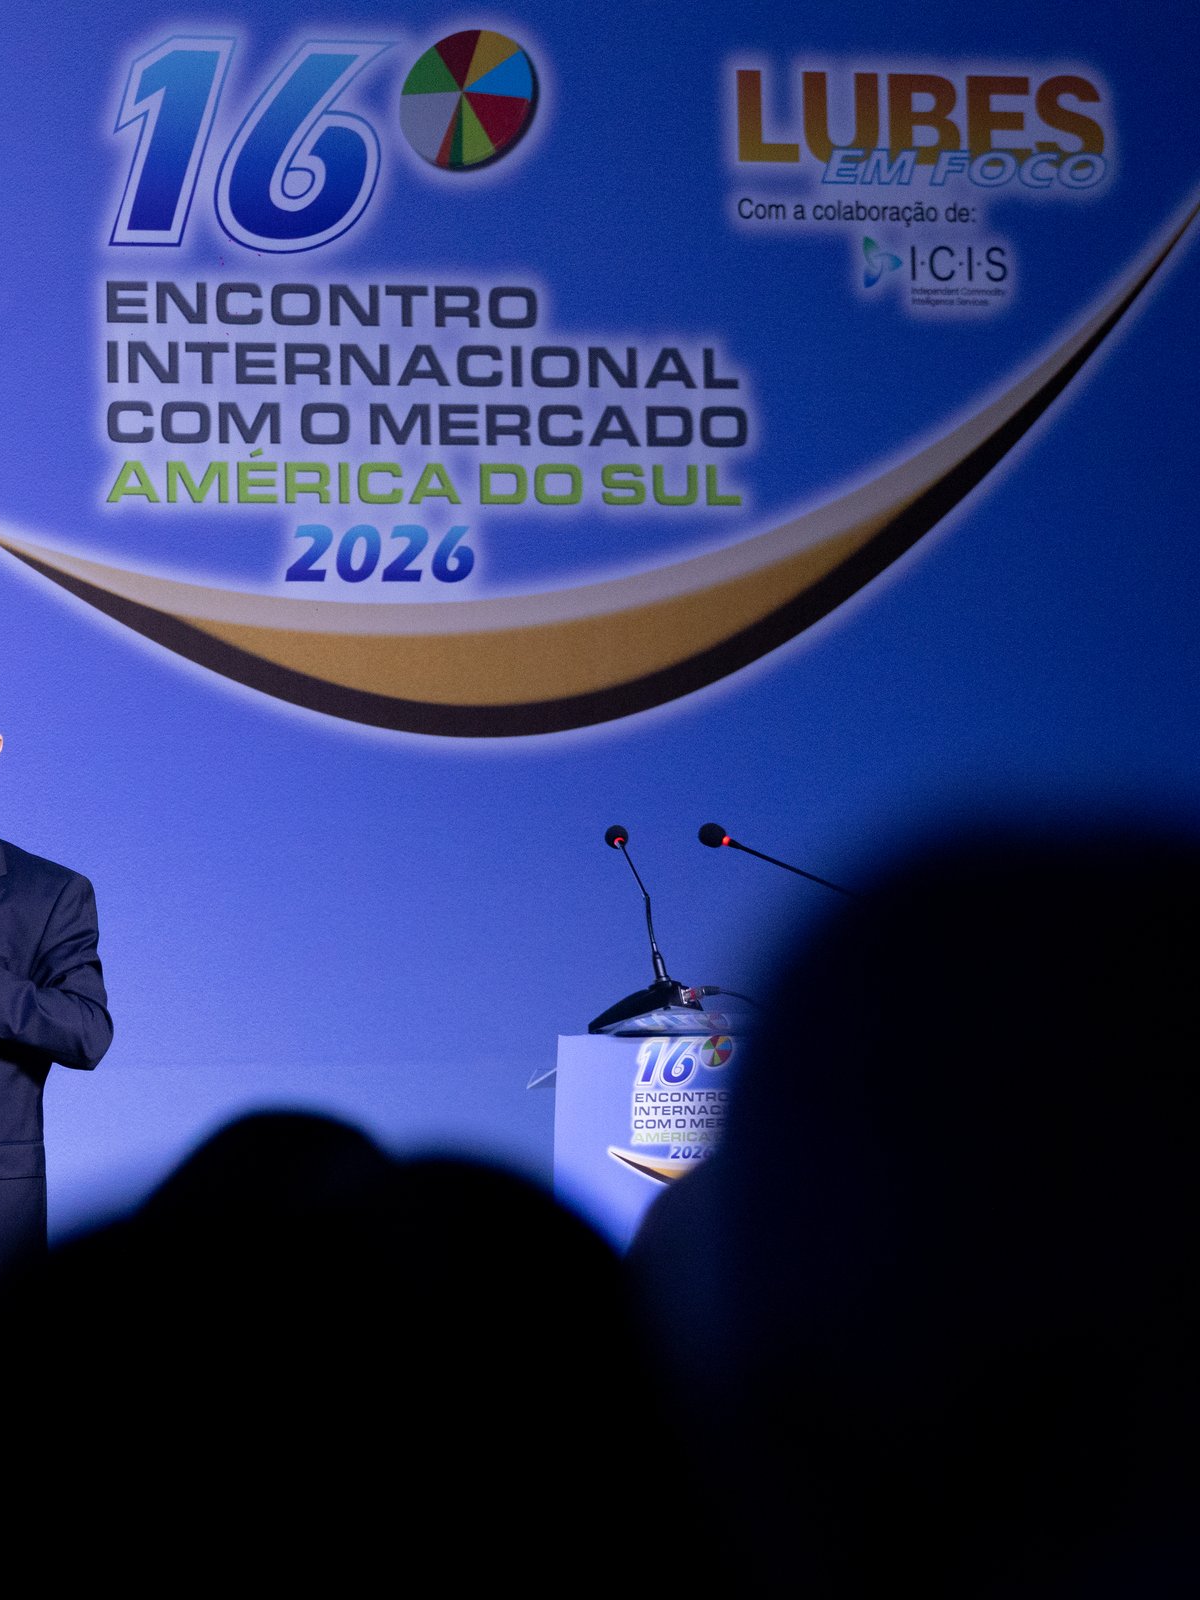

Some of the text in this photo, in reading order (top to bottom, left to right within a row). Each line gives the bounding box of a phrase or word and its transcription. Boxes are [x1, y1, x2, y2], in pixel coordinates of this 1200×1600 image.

[736, 70, 1104, 171] LUBES
[821, 146, 1107, 189] EM FOCO
[737, 198, 976, 228] Com a colaboração de:
[105, 280, 538, 329] ENCONTRO
[105, 340, 739, 390] INTERNACIONAL
[106, 400, 748, 448] COM O MERCADO
[106, 448, 742, 507] AMÉRICA DO SUL
[285, 524, 476, 584] 2026
[634, 1119, 672, 1129] COM
[675, 1118, 687, 1129] O
[634, 1129, 711, 1143] AMÉRICA
